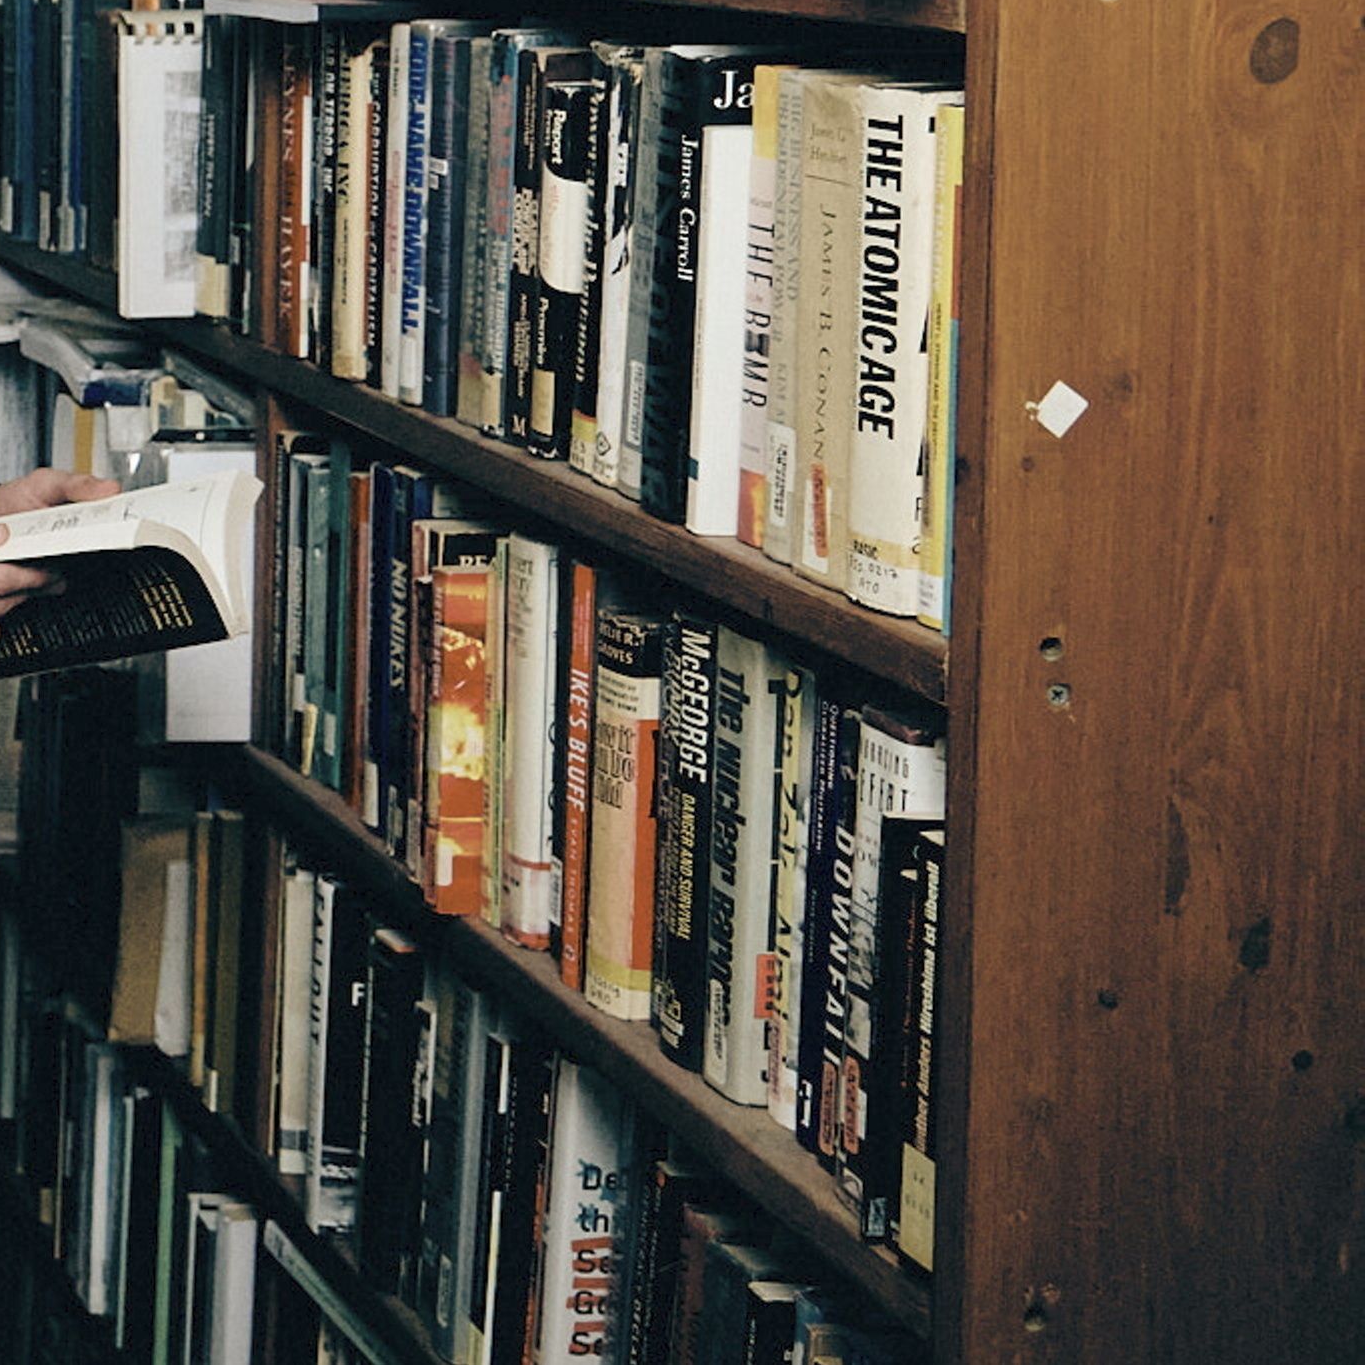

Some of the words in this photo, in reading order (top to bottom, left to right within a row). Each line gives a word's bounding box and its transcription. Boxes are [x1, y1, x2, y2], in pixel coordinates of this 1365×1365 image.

[323, 71, 336, 93] ON
[406, 36, 426, 188] CODE-NAME
[587, 79, 605, 159] Power
[370, 104, 381, 217] CORRUPTION
[551, 109, 567, 164] Report
[680, 134, 698, 199] James
[865, 115, 904, 191] THE
[788, 131, 802, 250] BUSINESS
[278, 216, 294, 320] HAYEK
[401, 190, 424, 335] DOWNFALL
[676, 207, 695, 283] Carroll
[746, 222, 775, 288] THE
[786, 257, 799, 301] AND
[818, 204, 837, 299] JAMES
[859, 195, 903, 355] ATOMIC
[367, 242, 378, 347] CAPITALISM
[536, 297, 549, 365] Proxmire
[814, 345, 830, 460] CONAN
[856, 357, 897, 439] AGE
[389, 559, 407, 602] NO
[388, 603, 406, 692] NUKES
[568, 669, 589, 729] IKE'S
[678, 632, 711, 783] McGEORGE
[717, 667, 751, 734] The
[566, 738, 588, 812] BLUFF
[827, 705, 838, 790] QUESTIONING
[567, 817, 578, 860] EVAN
[680, 793, 696, 847] DANGER
[712, 738, 747, 888] Nuclear
[679, 849, 694, 874] AND
[923, 859, 940, 921] überall
[565, 869, 577, 932] THOMAS
[675, 875, 692, 939] SURVIVAL
[921, 923, 936, 947] ist
[822, 825, 856, 1066] DOWNFALL
[919, 948, 936, 1035] Hiroshima
[915, 1036, 932, 1097] Anders
